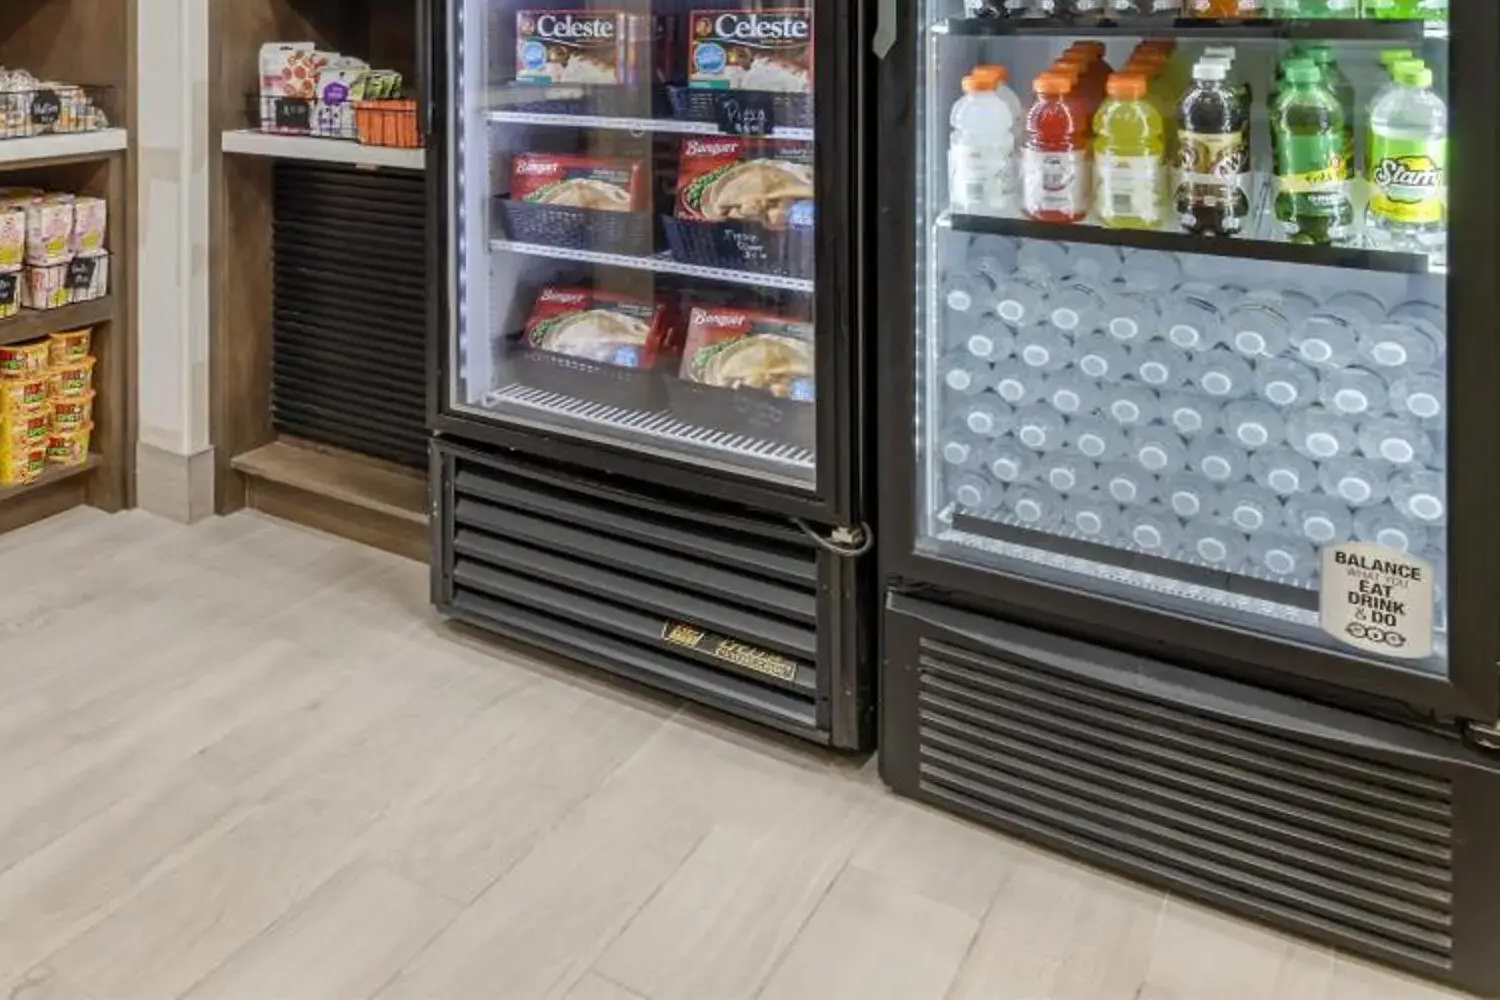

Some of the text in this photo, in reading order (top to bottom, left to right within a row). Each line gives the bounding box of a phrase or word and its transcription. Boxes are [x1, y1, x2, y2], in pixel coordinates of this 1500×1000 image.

[537, 14, 614, 38] Celeste
[714, 13, 809, 38] Celeste
[1335, 551, 1421, 581] BALANCE
[1358, 579, 1393, 599] EAT
[1347, 591, 1406, 617] DRINK
[1371, 610, 1397, 627] DO
